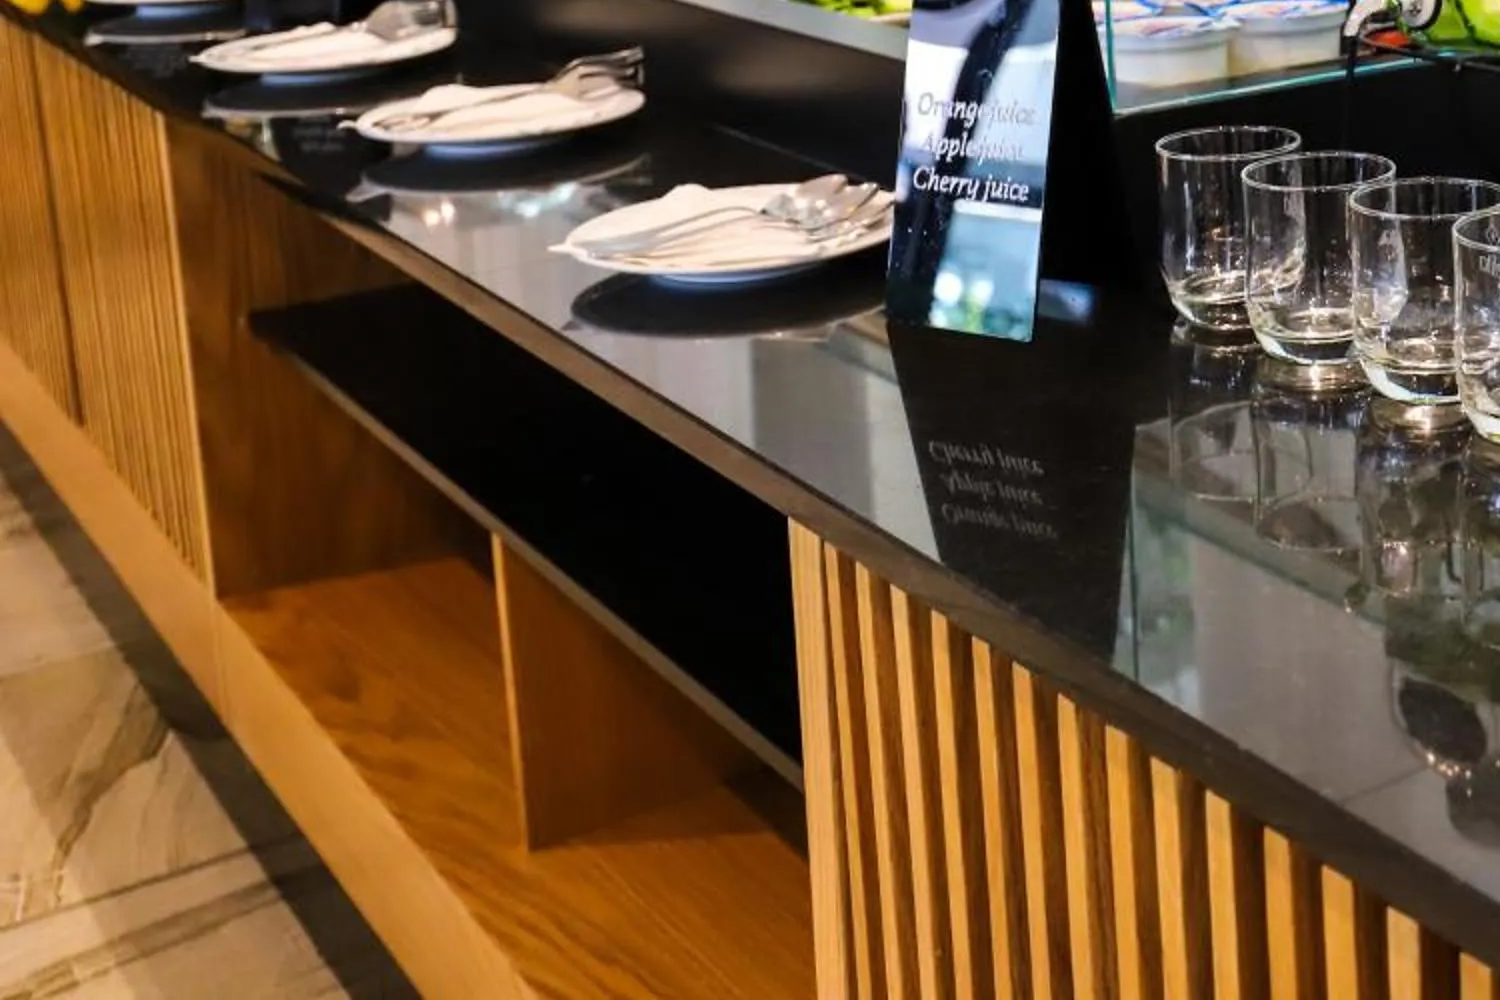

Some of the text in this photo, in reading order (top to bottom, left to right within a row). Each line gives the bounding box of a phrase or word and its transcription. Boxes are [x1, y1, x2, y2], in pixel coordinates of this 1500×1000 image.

[917, 91, 987, 129] Orange
[921, 131, 978, 163] Apple
[912, 166, 1030, 203] Cherry juice
